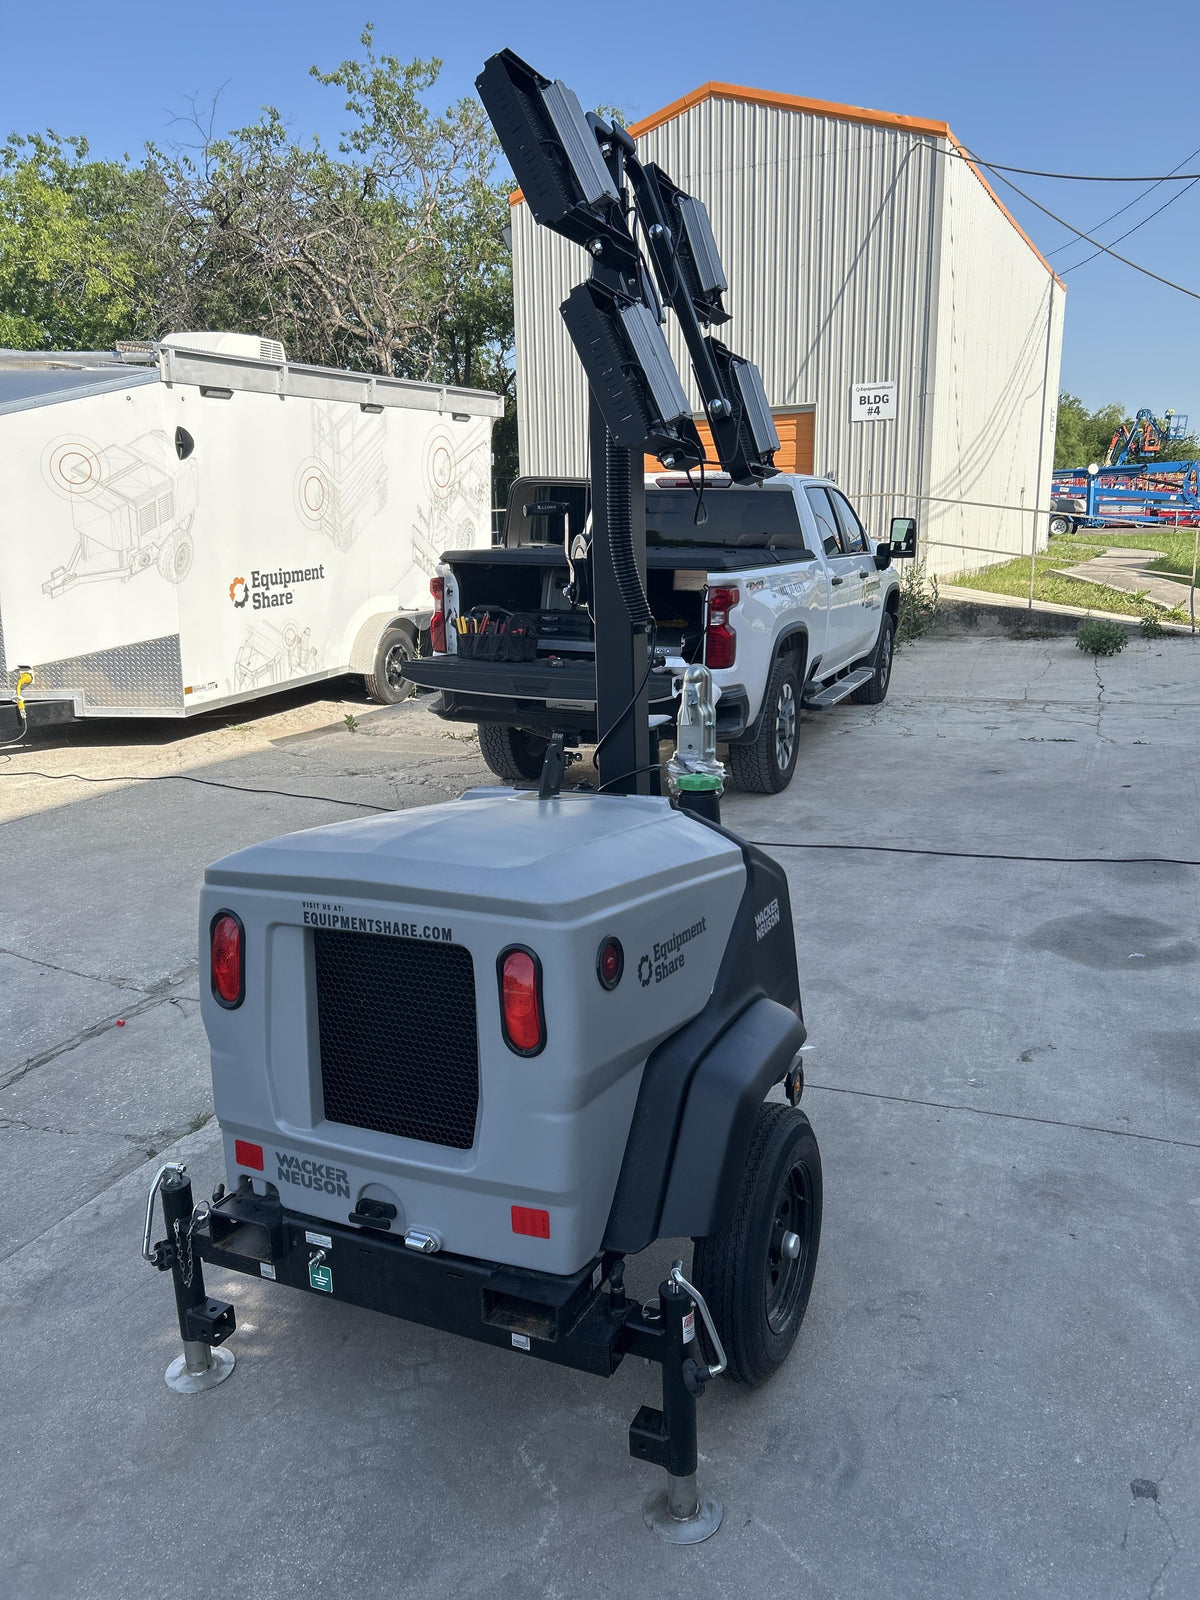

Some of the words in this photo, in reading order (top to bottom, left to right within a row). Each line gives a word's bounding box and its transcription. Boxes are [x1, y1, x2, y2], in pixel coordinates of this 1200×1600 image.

[859, 394, 889, 405] BLDG
[867, 406, 880, 416] #4
[251, 564, 324, 590] Equipment
[252, 592, 293, 610] Share
[302, 901, 320, 910] VISIT
[754, 898, 779, 927] WACKER
[303, 912, 452, 941] EQUIPMENTSHARE.COM
[652, 916, 706, 962] Equipment
[756, 910, 780, 942] NEUSON
[654, 954, 685, 983] Share
[275, 1152, 350, 1184] WACKER
[278, 1167, 350, 1199] NEUSON
